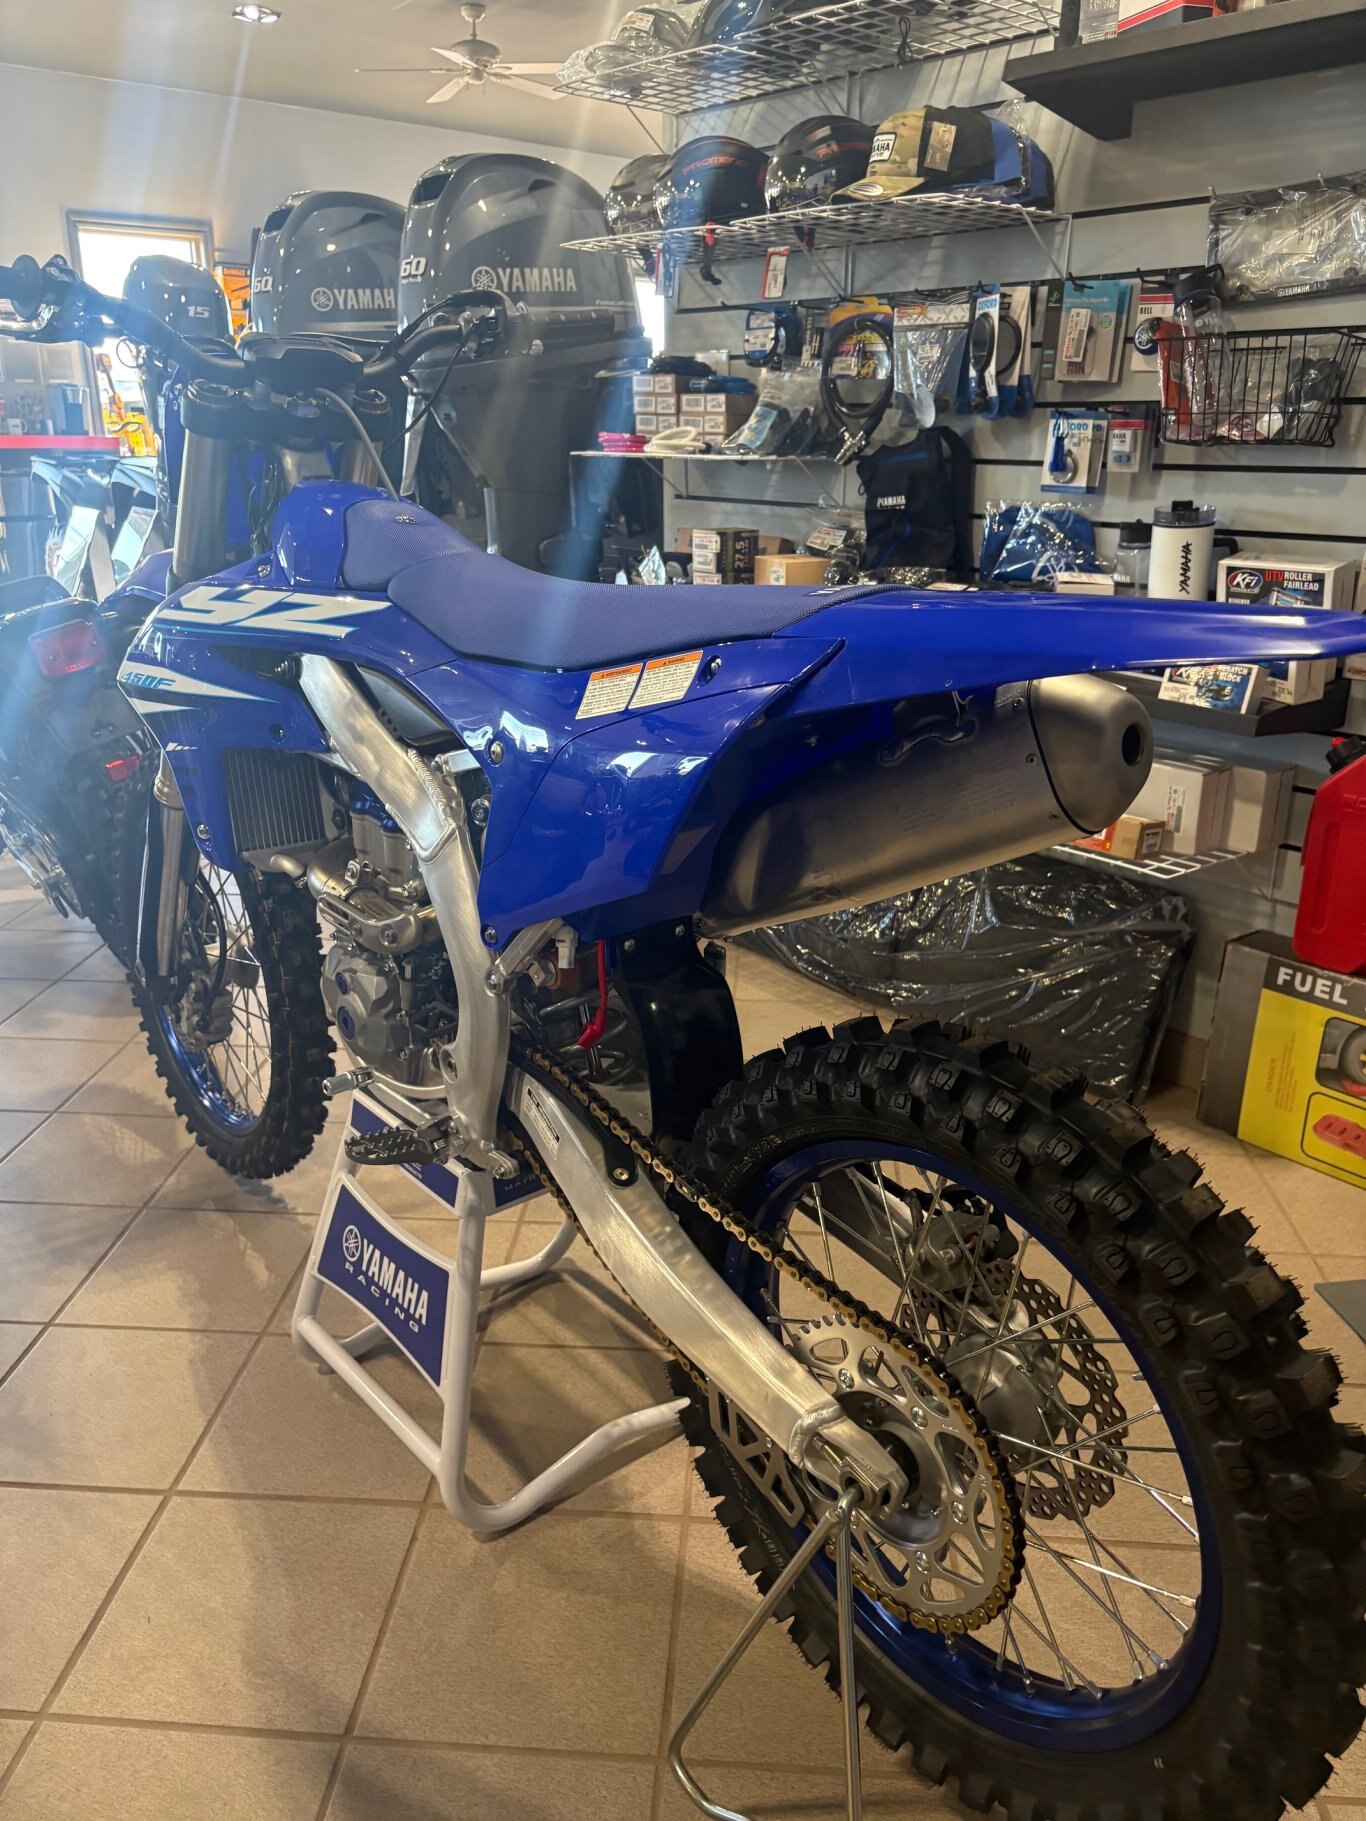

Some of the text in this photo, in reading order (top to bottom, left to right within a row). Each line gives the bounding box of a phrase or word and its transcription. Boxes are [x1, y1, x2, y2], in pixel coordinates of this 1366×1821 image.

[400, 257, 427, 278] 60
[497, 267, 577, 293] YAMAHA
[187, 305, 211, 318] 15
[333, 288, 397, 310] YAMAH
[734, 541, 745, 569] 27.5
[1179, 541, 1193, 595] YAMAHA
[1265, 570, 1313, 582] UTV ROLLER
[1283, 581, 1319, 592] FAIRLEAD
[154, 586, 393, 638] YZ
[120, 670, 176, 689] 450F
[1276, 966, 1348, 1006] FUEL
[361, 1238, 430, 1327] YAMAHA
[344, 1263, 420, 1334] RACING
